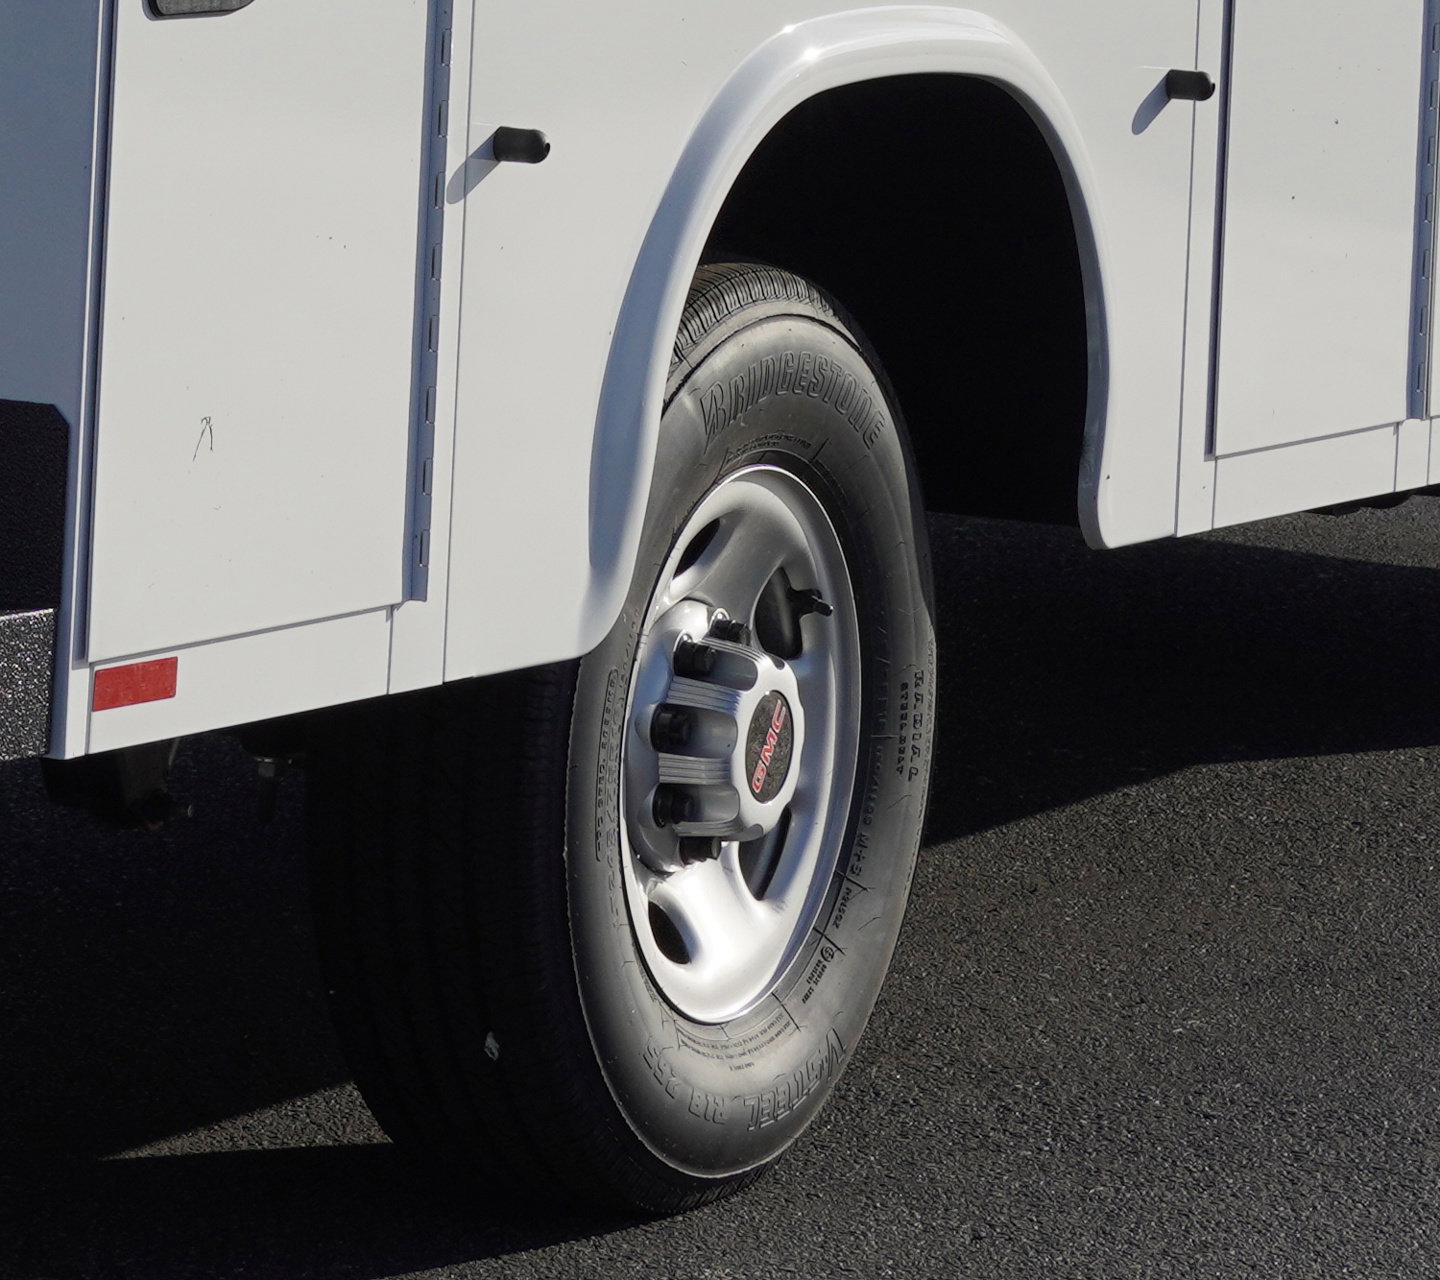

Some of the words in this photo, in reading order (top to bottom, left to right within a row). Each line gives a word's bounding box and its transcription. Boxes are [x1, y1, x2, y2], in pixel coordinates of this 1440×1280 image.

[700, 351, 886, 455] BRIDGESTONE
[752, 698, 787, 793] GMC
[907, 669, 925, 783] RADIAL
